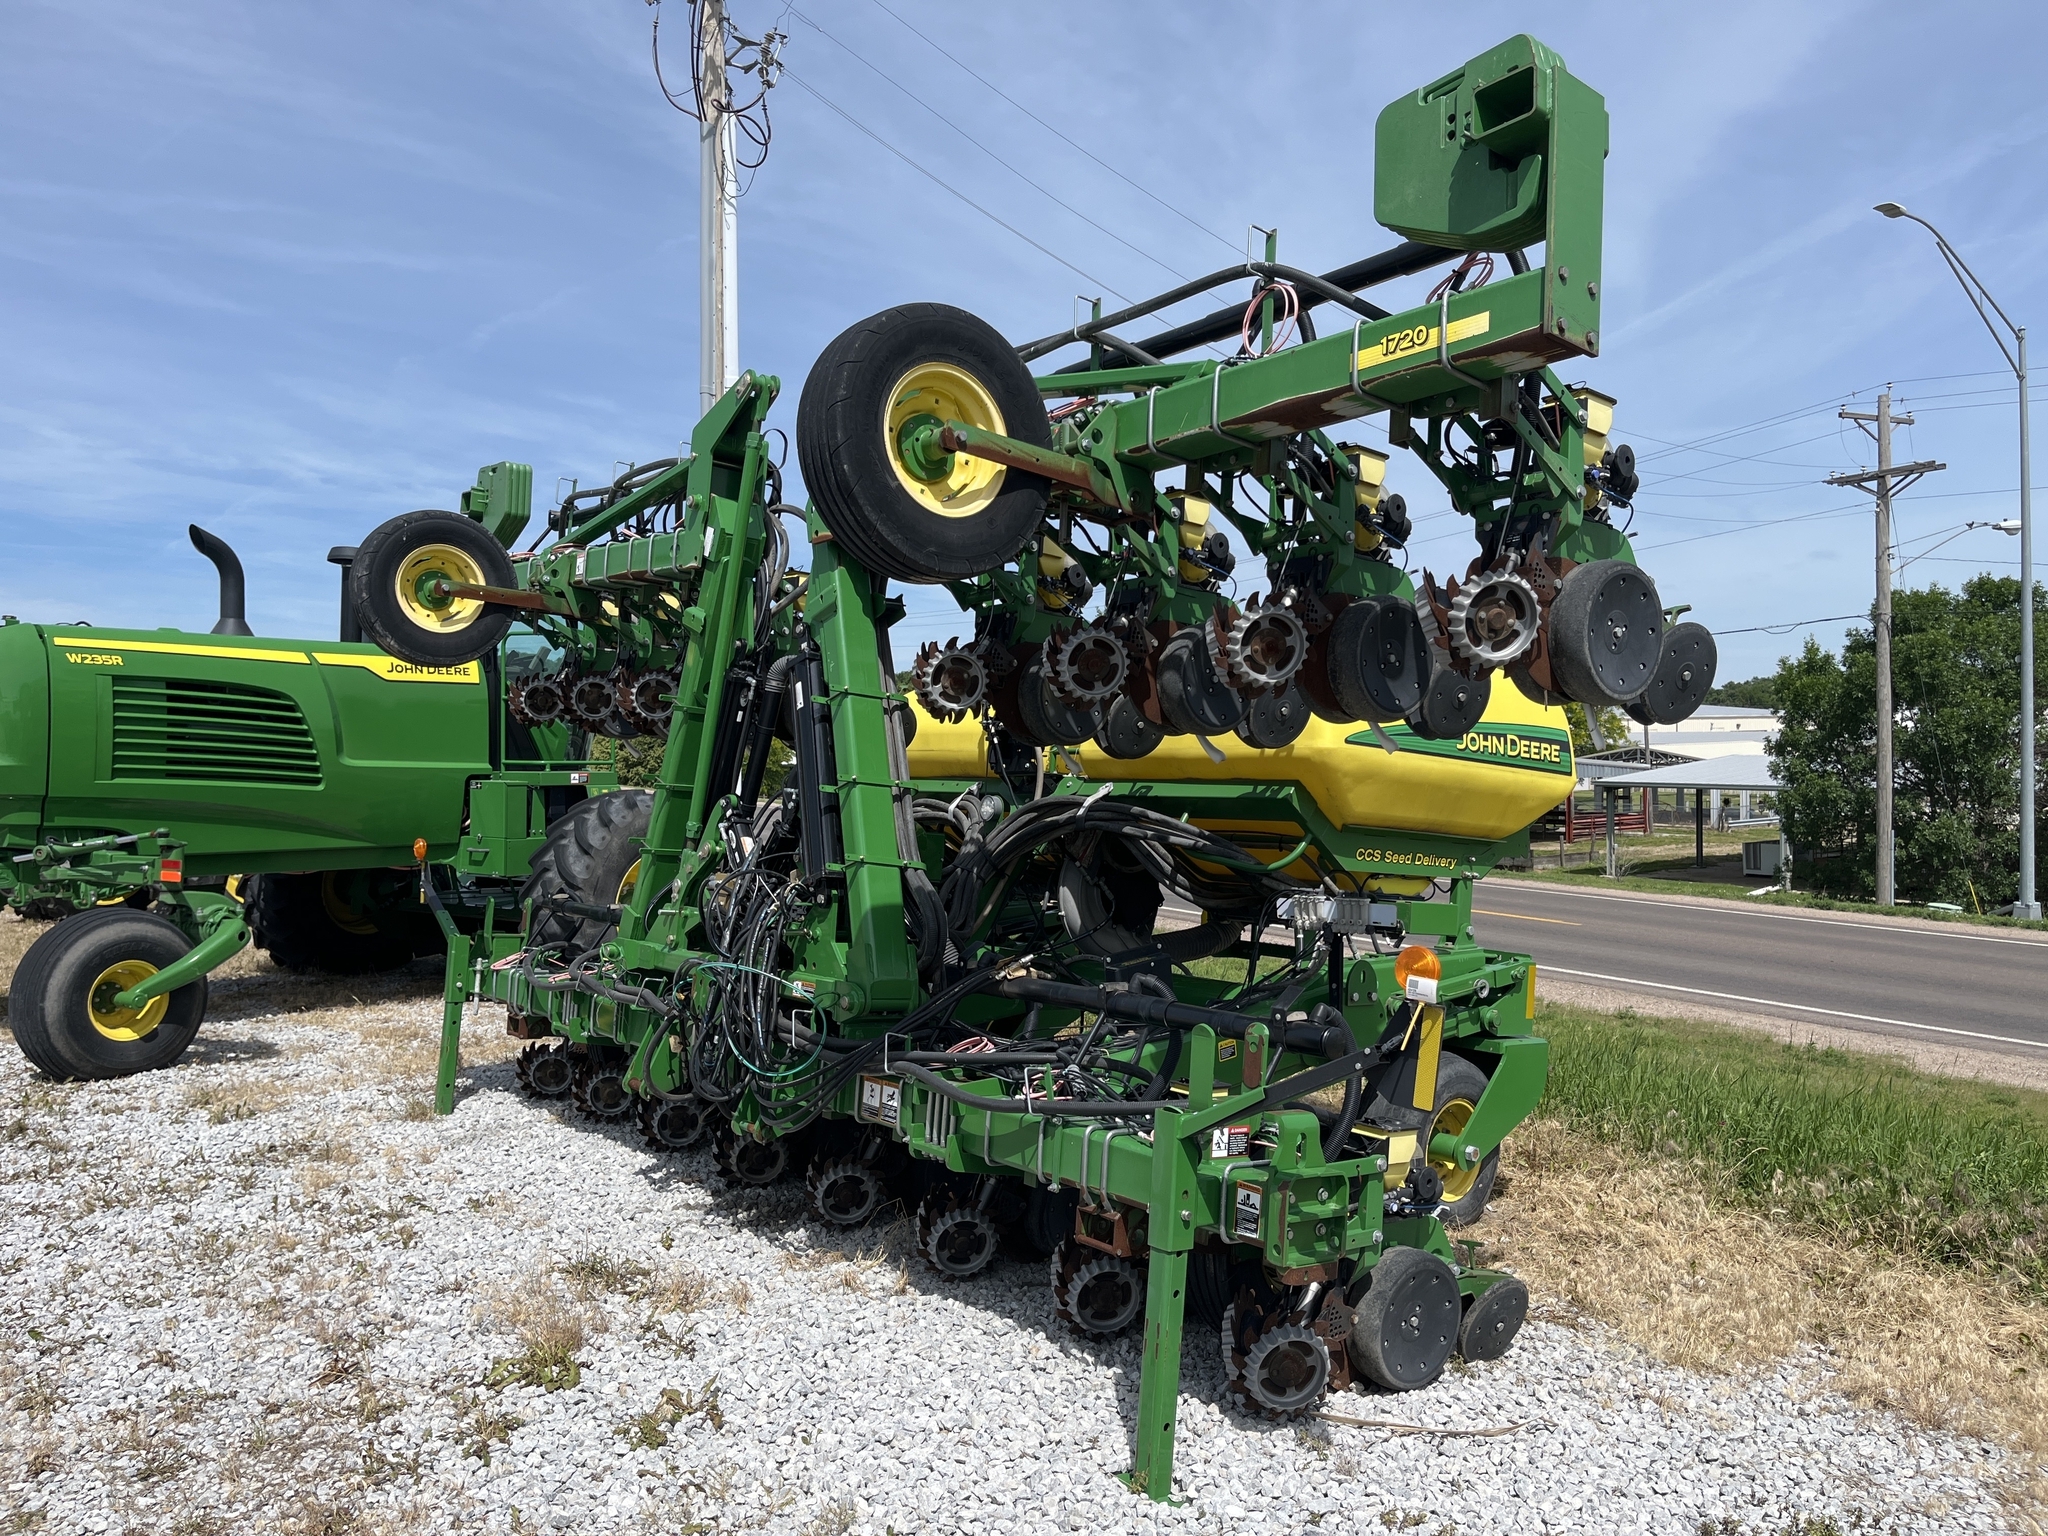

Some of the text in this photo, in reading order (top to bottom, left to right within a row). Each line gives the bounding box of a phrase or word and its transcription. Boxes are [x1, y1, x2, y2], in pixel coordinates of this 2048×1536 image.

[1380, 325, 1429, 356] 1720
[65, 652, 125, 666] W235R
[387, 662, 471, 676] JOHN DEERE
[1456, 732, 1561, 764] JOHN DEERE
[1356, 848, 1457, 870] CCS Seed Delivery
